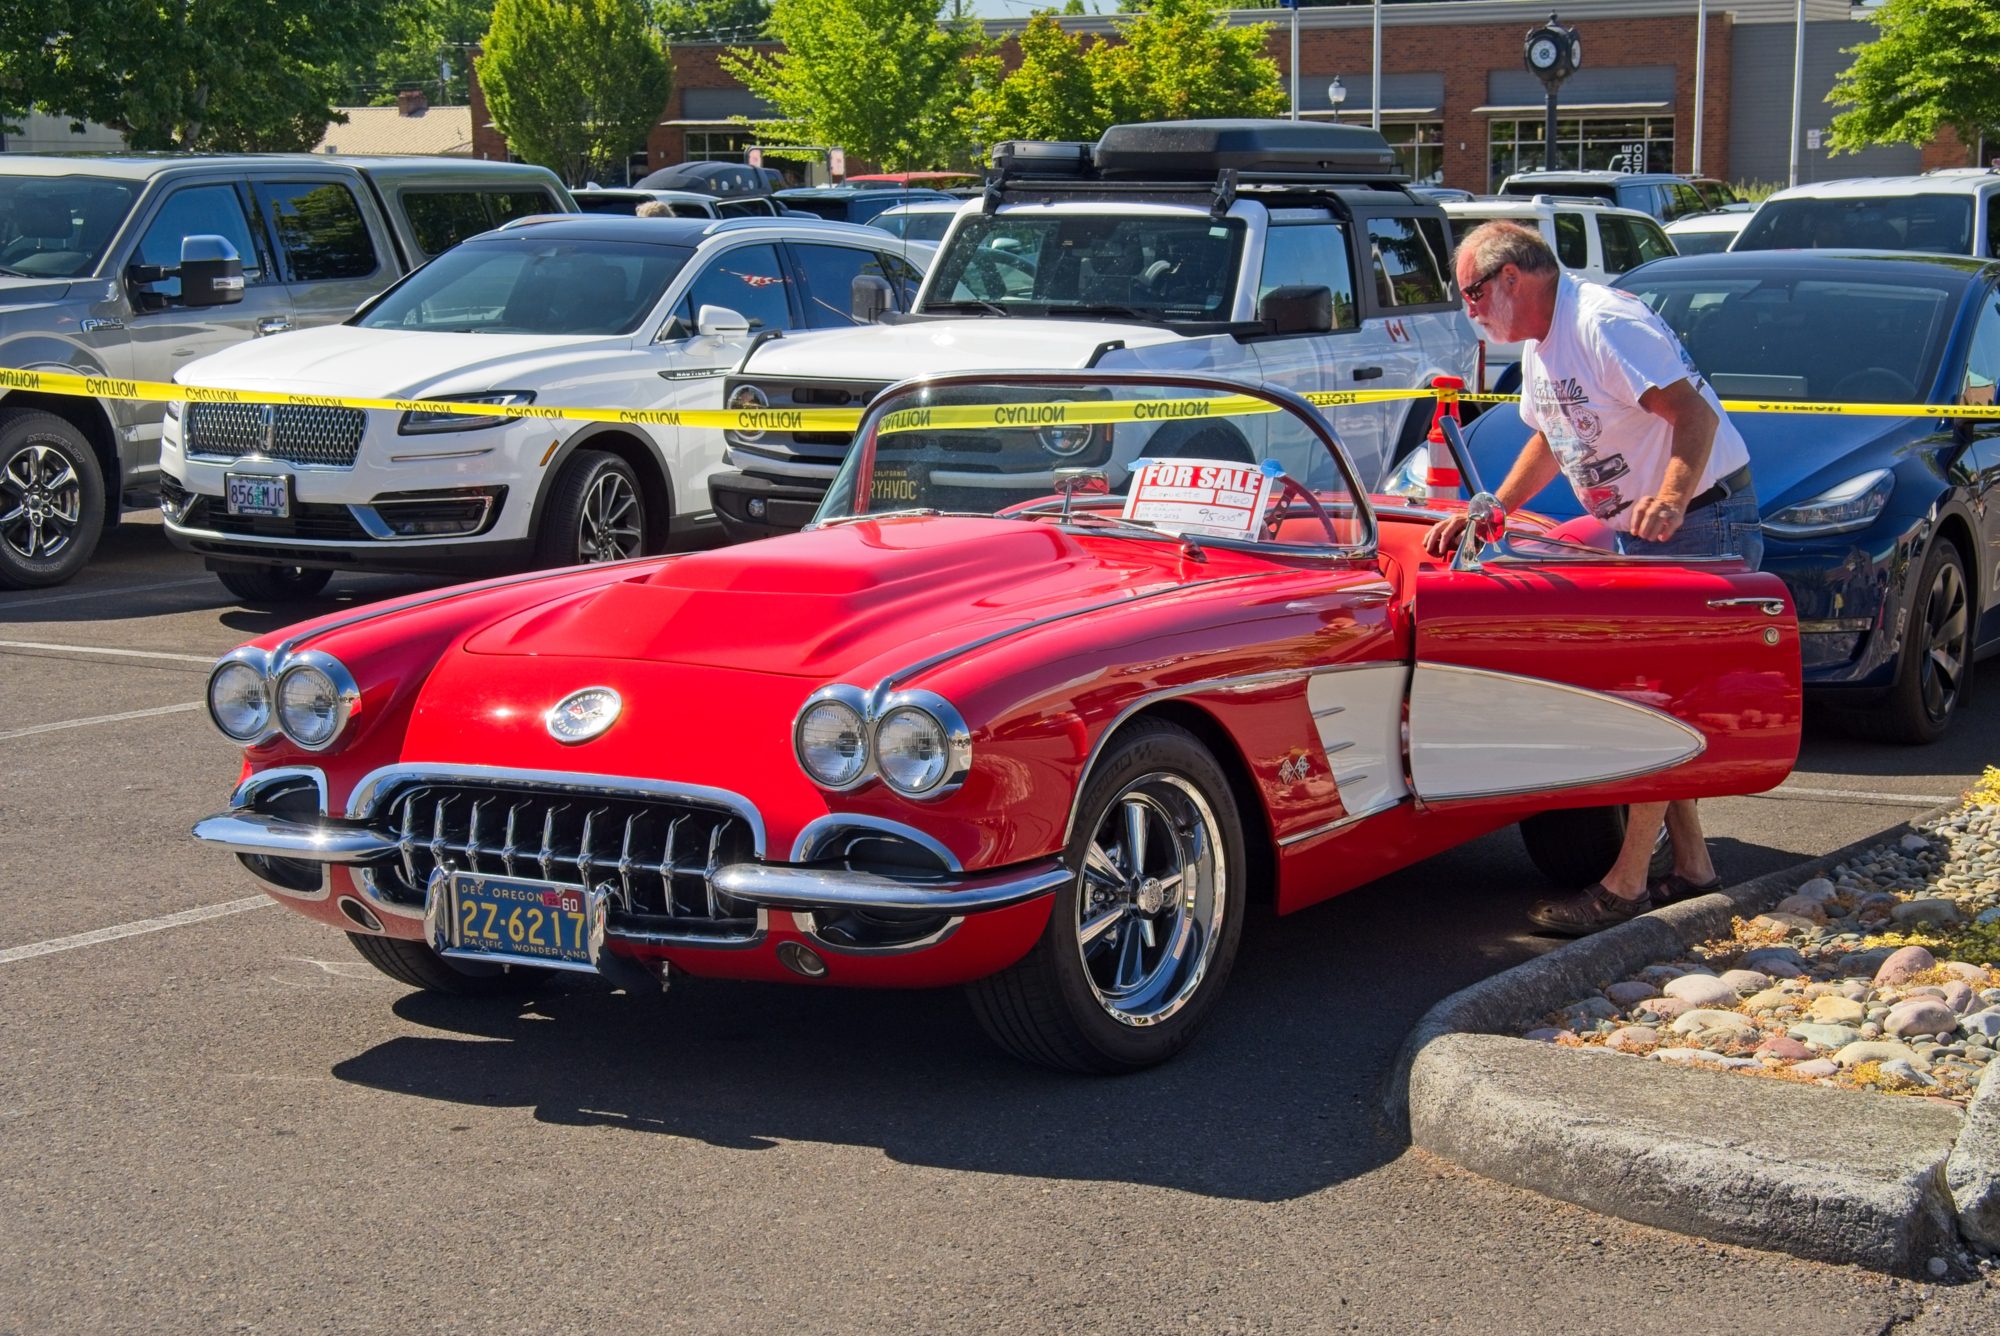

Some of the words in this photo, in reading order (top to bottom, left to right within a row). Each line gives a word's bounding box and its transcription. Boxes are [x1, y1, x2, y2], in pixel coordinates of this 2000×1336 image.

[1143, 465, 1193, 486] FOR
[1197, 467, 1262, 493] SALE
[231, 485, 254, 505] 856
[262, 487, 284, 507] MJC
[492, 888, 544, 903] OREGON
[562, 898, 578, 911] 60
[464, 937, 503, 949] PACIFIC
[512, 943, 588, 959] WONDERLAND
